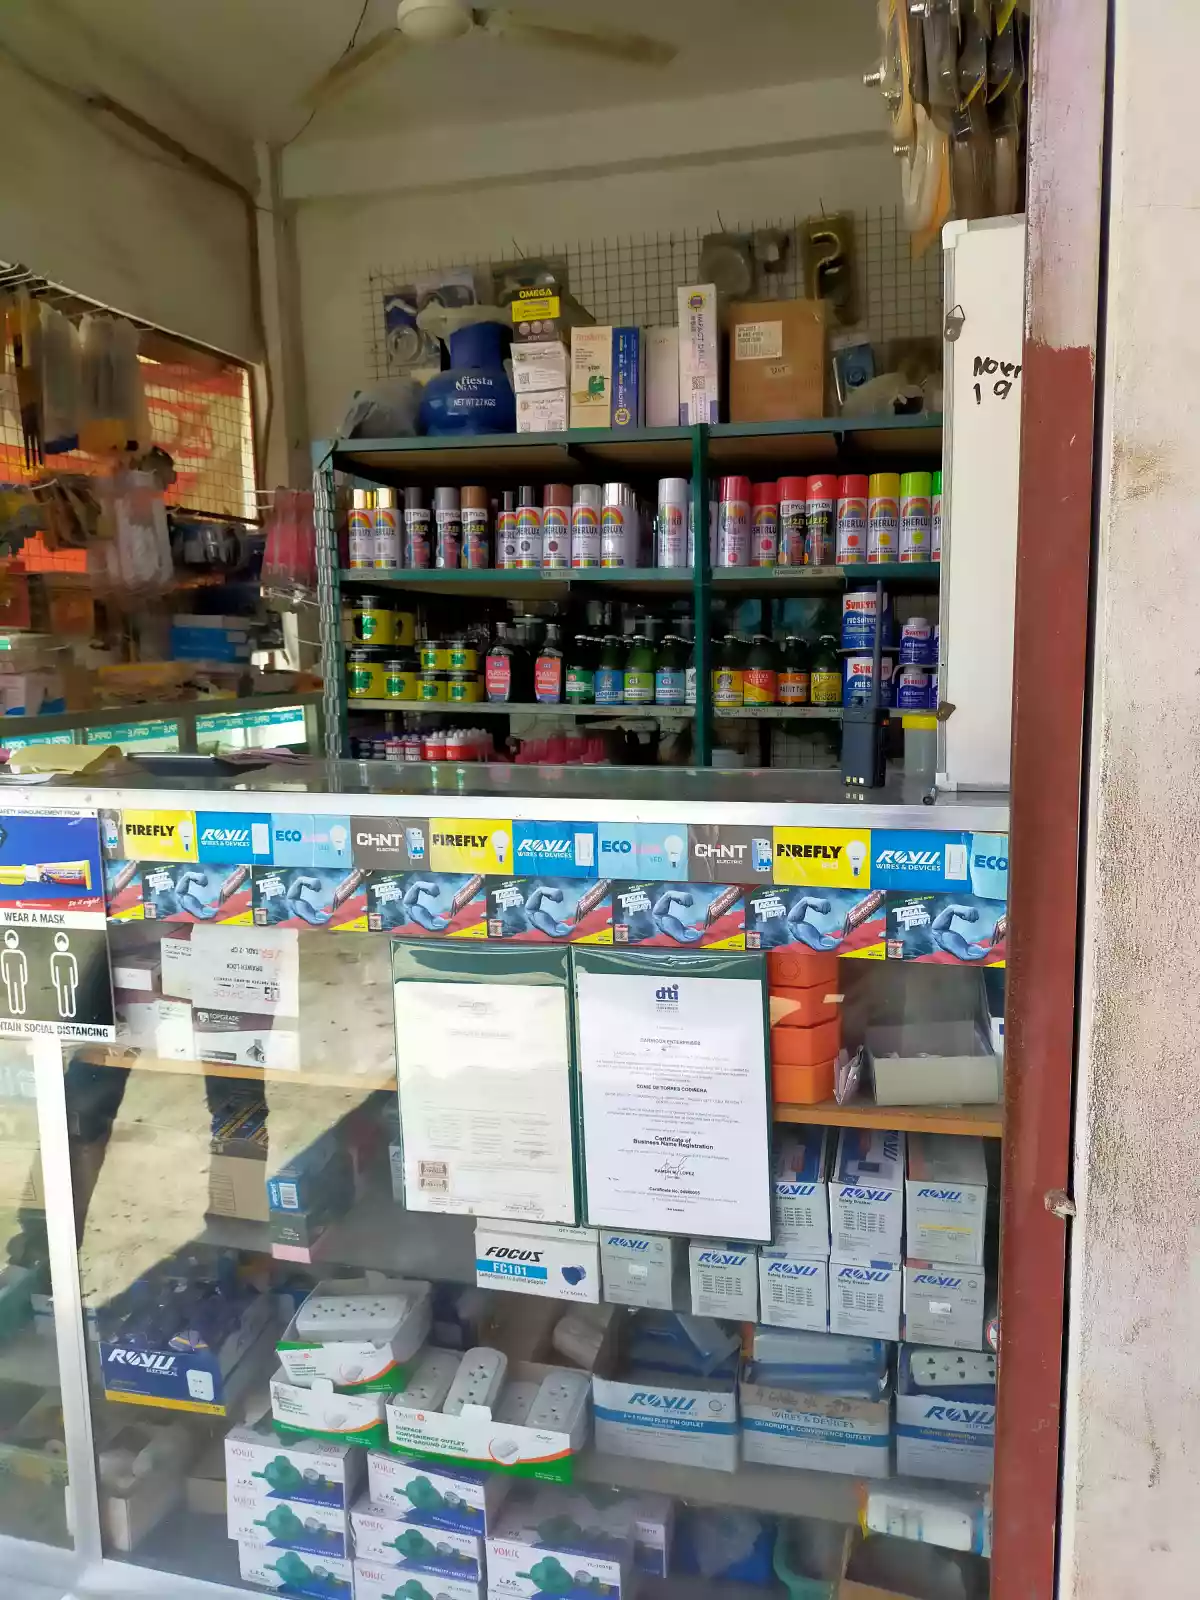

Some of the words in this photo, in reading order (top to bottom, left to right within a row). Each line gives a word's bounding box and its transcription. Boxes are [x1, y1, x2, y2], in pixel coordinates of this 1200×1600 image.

[519, 288, 552, 298] OMEGA
[461, 375, 493, 386] fiesta
[453, 398, 464, 407] NET
[125, 824, 175, 837] FIREFLY
[432, 833, 488, 848] FIREFLY
[601, 840, 632, 854] ECO
[776, 843, 842, 859] FIREFLY
[876, 850, 940, 864] ROYU
[876, 863, 899, 871] WIRES
[974, 854, 1008, 871] ECO
[4, 912, 29, 923] WEAR
[31, 913, 38, 923] A
[40, 913, 65, 924] MASK
[892, 904, 927, 922] TAGAL
[655, 983, 679, 1000] dti
[209, 1012, 240, 1021] TOPGRADE
[24, 1023, 54, 1034] SOCIAL
[57, 1025, 109, 1037] DISTANCING
[633, 1138, 660, 1146] Business
[678, 1142, 714, 1150] Registration
[654, 1135, 684, 1144] Certificate
[840, 1187, 893, 1202] ROYU
[917, 1188, 962, 1200] ROYU
[607, 1236, 650, 1249] ROYU
[485, 1246, 543, 1263] FOCUS
[698, 1252, 748, 1266] ROYU
[493, 1262, 527, 1276] FC101
[768, 1262, 818, 1276] ROYU
[838, 1268, 891, 1282] ROYU
[914, 1274, 962, 1288] ROYU
[108, 1348, 176, 1370] ROYU
[146, 1368, 178, 1377] ELECTRICAL
[628, 1392, 696, 1411] ROYU
[924, 1405, 995, 1424] ROYU
[395, 1425, 422, 1434] SURFACE
[681, 1420, 704, 1428] OUTLET
[754, 1420, 795, 1431] QUADRUPLE
[796, 1426, 843, 1438] CONVENIENCE
[845, 1432, 872, 1441] OUTLET
[396, 1431, 440, 1443] CONVENIENCE
[441, 1438, 465, 1446] OUTLET
[413, 1438, 440, 1449] GROUND
